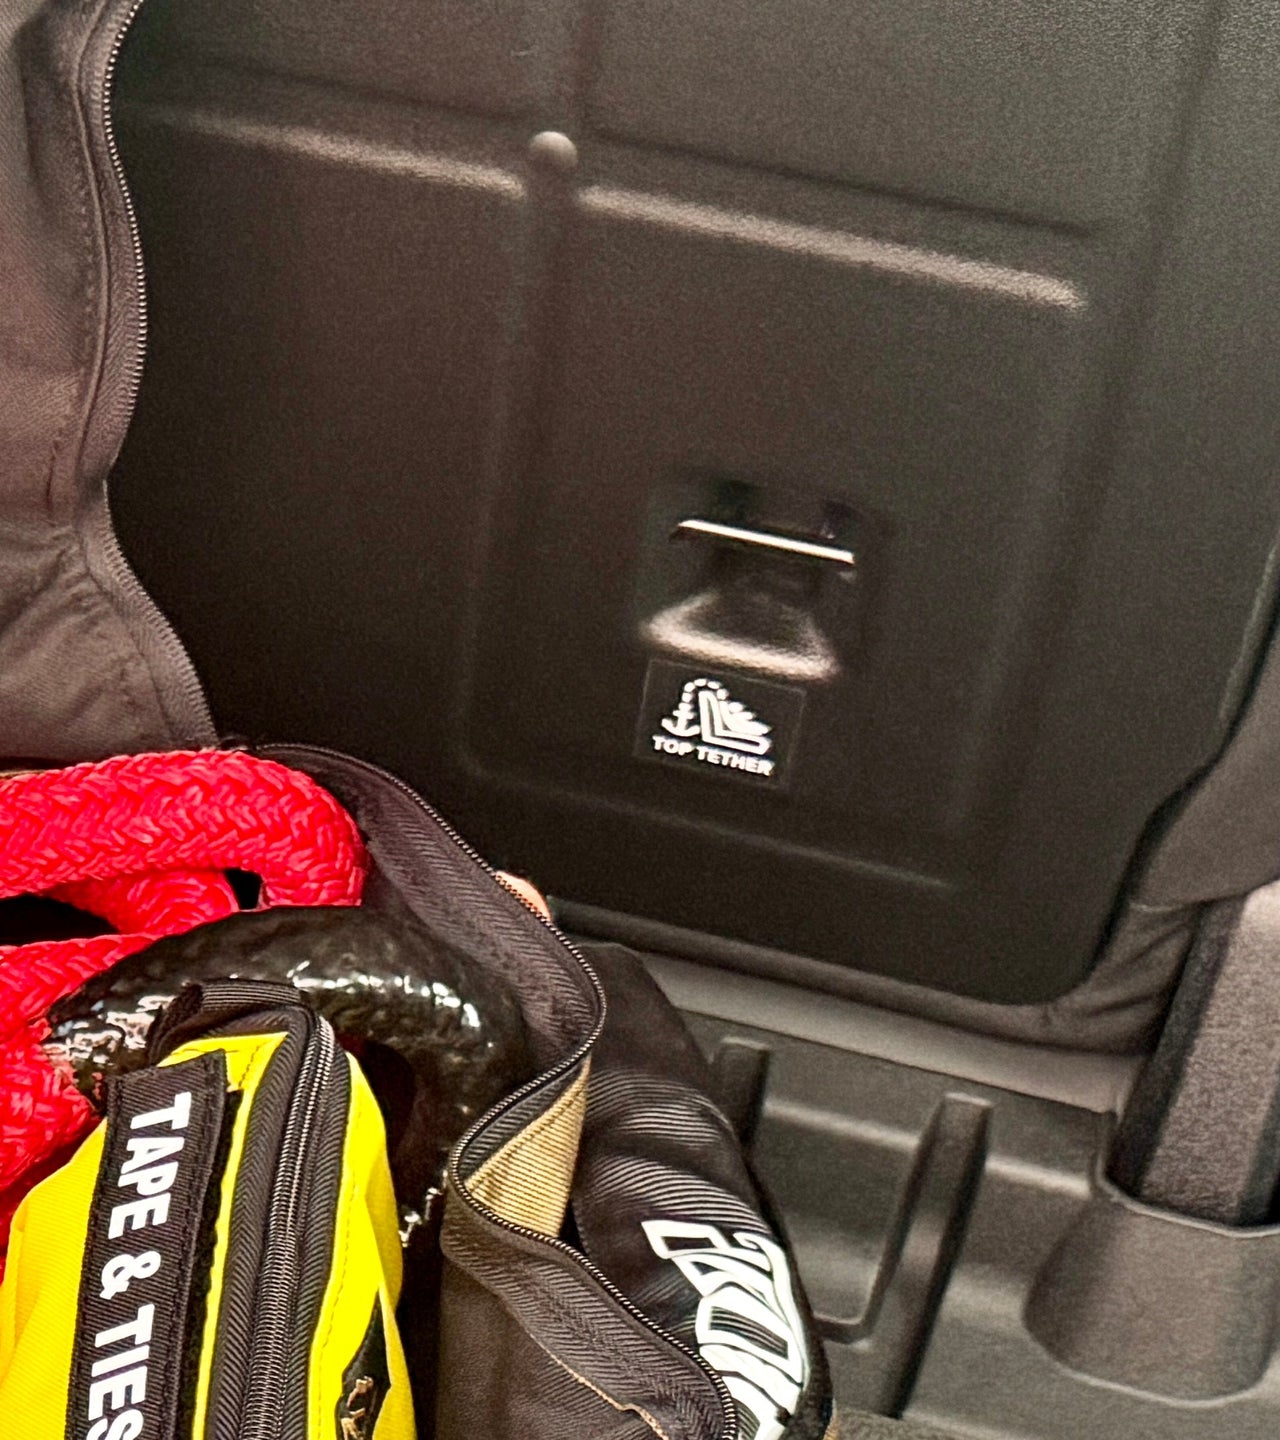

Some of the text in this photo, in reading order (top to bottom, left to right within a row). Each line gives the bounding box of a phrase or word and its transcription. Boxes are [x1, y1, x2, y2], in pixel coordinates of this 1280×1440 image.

[652, 735, 774, 776] TOP TETHER
[108, 1091, 192, 1240] TAPE
[100, 1250, 161, 1300] &
